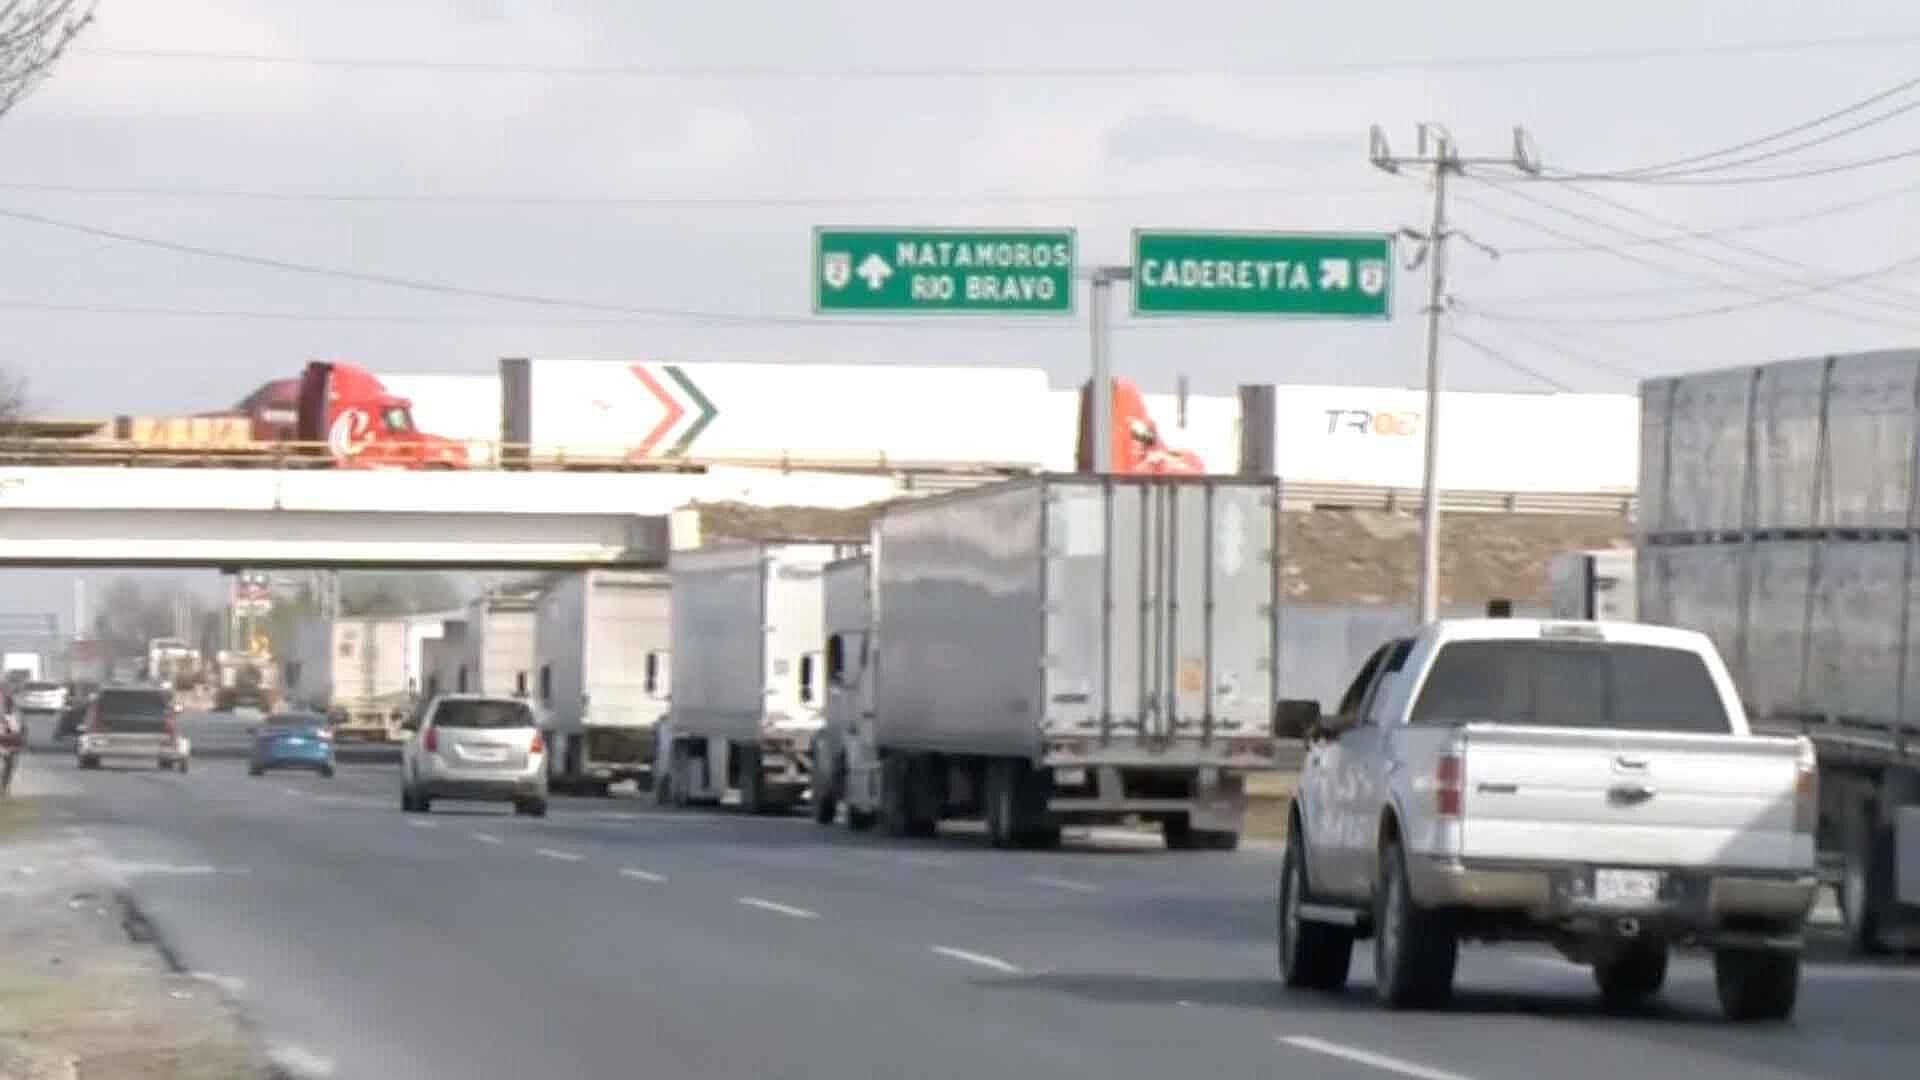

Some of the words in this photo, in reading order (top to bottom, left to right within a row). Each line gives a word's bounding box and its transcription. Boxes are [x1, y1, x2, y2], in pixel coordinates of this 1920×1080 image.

[911, 275, 955, 300] RIO
[965, 276, 1056, 300] BRAVO
[1142, 259, 1309, 289] CADEREYTA
